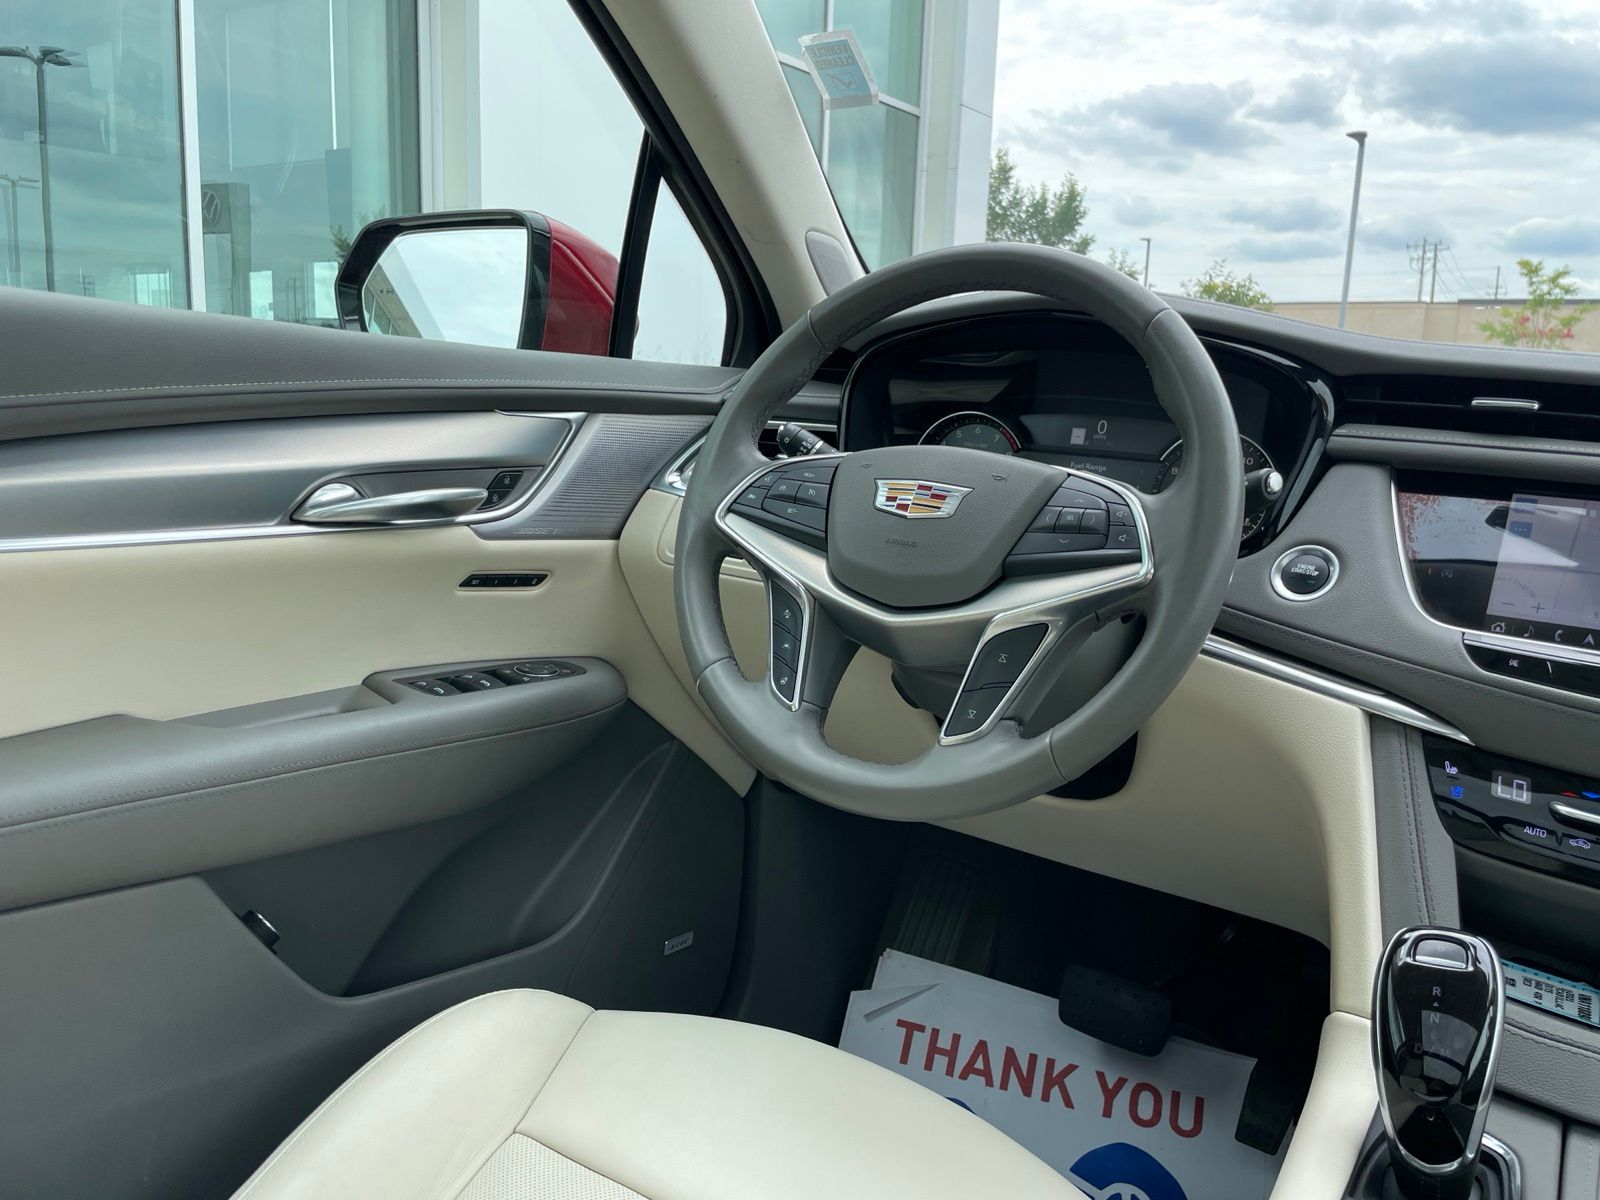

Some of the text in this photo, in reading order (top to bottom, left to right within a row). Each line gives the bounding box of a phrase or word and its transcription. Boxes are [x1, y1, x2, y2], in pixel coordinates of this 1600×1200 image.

[974, 426, 981, 434] 6
[1097, 419, 1108, 435] 0
[955, 430, 962, 439] 5
[1070, 461, 1108, 473] Fuel Range
[1523, 825, 1547, 838] AUTO
[1432, 986, 1441, 997] R
[1430, 1012, 1440, 1024] N
[896, 1018, 1205, 1139] THANK YOU
